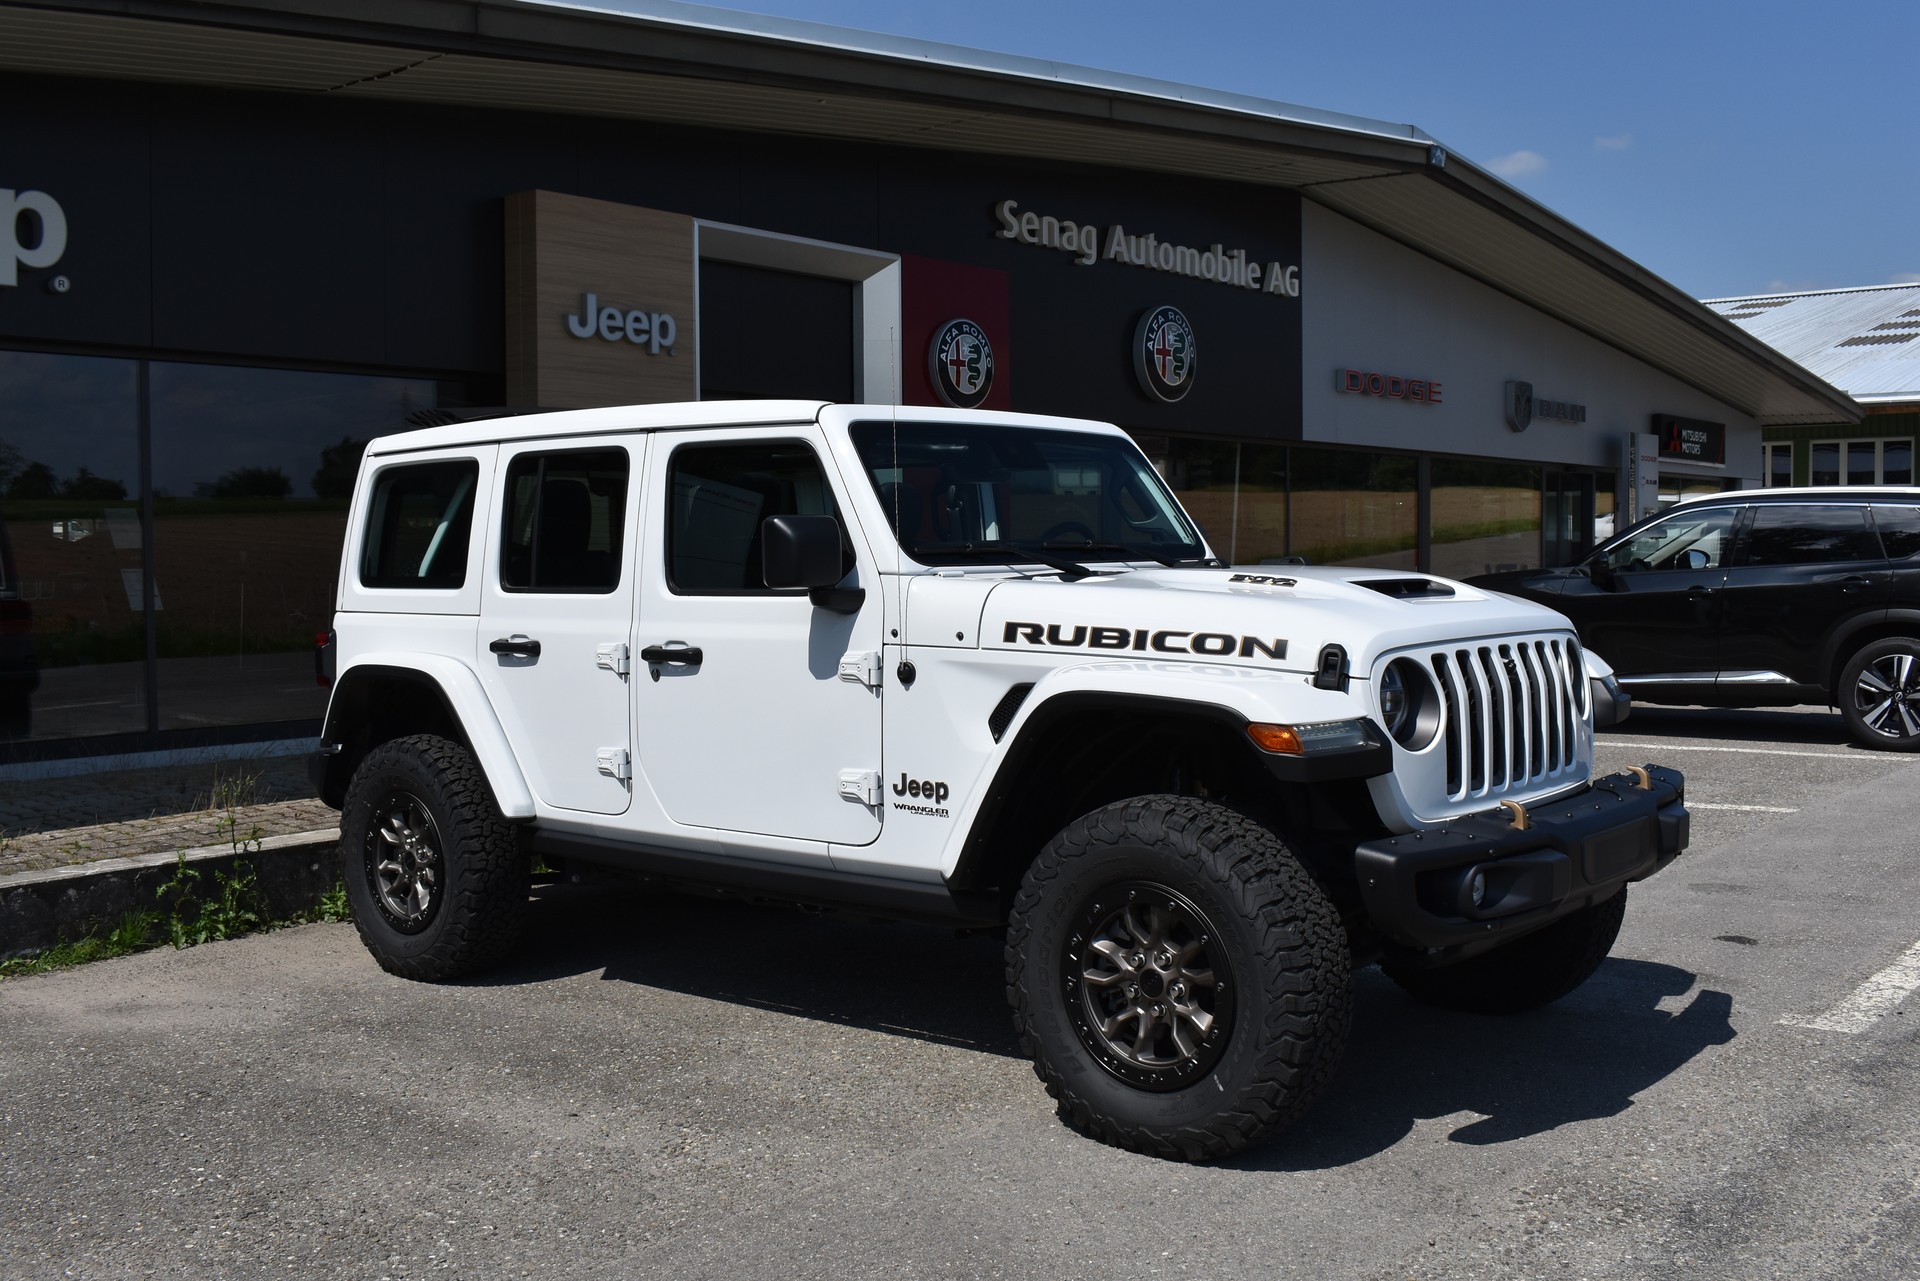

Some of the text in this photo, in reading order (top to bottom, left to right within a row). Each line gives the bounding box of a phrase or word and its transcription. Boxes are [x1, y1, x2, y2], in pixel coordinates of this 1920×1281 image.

[996, 200, 1300, 298] Senag Automobile AG
[565, 292, 677, 356] Jeep
[1147, 311, 1195, 358] ALFA ROMEO
[940, 324, 992, 368] ALFA ROMEO
[1343, 368, 1443, 404] DODGE
[1537, 398, 1587, 423] RAM
[1681, 429, 1708, 443] MITSUBISHI
[1681, 442, 1701, 455] MOTORS
[1640, 455, 1657, 463] DODGE
[1002, 621, 1289, 661] RUBICON
[892, 772, 950, 805] Jeep
[893, 802, 949, 815] WRANGLER
[910, 811, 950, 819] UNLIMITED
